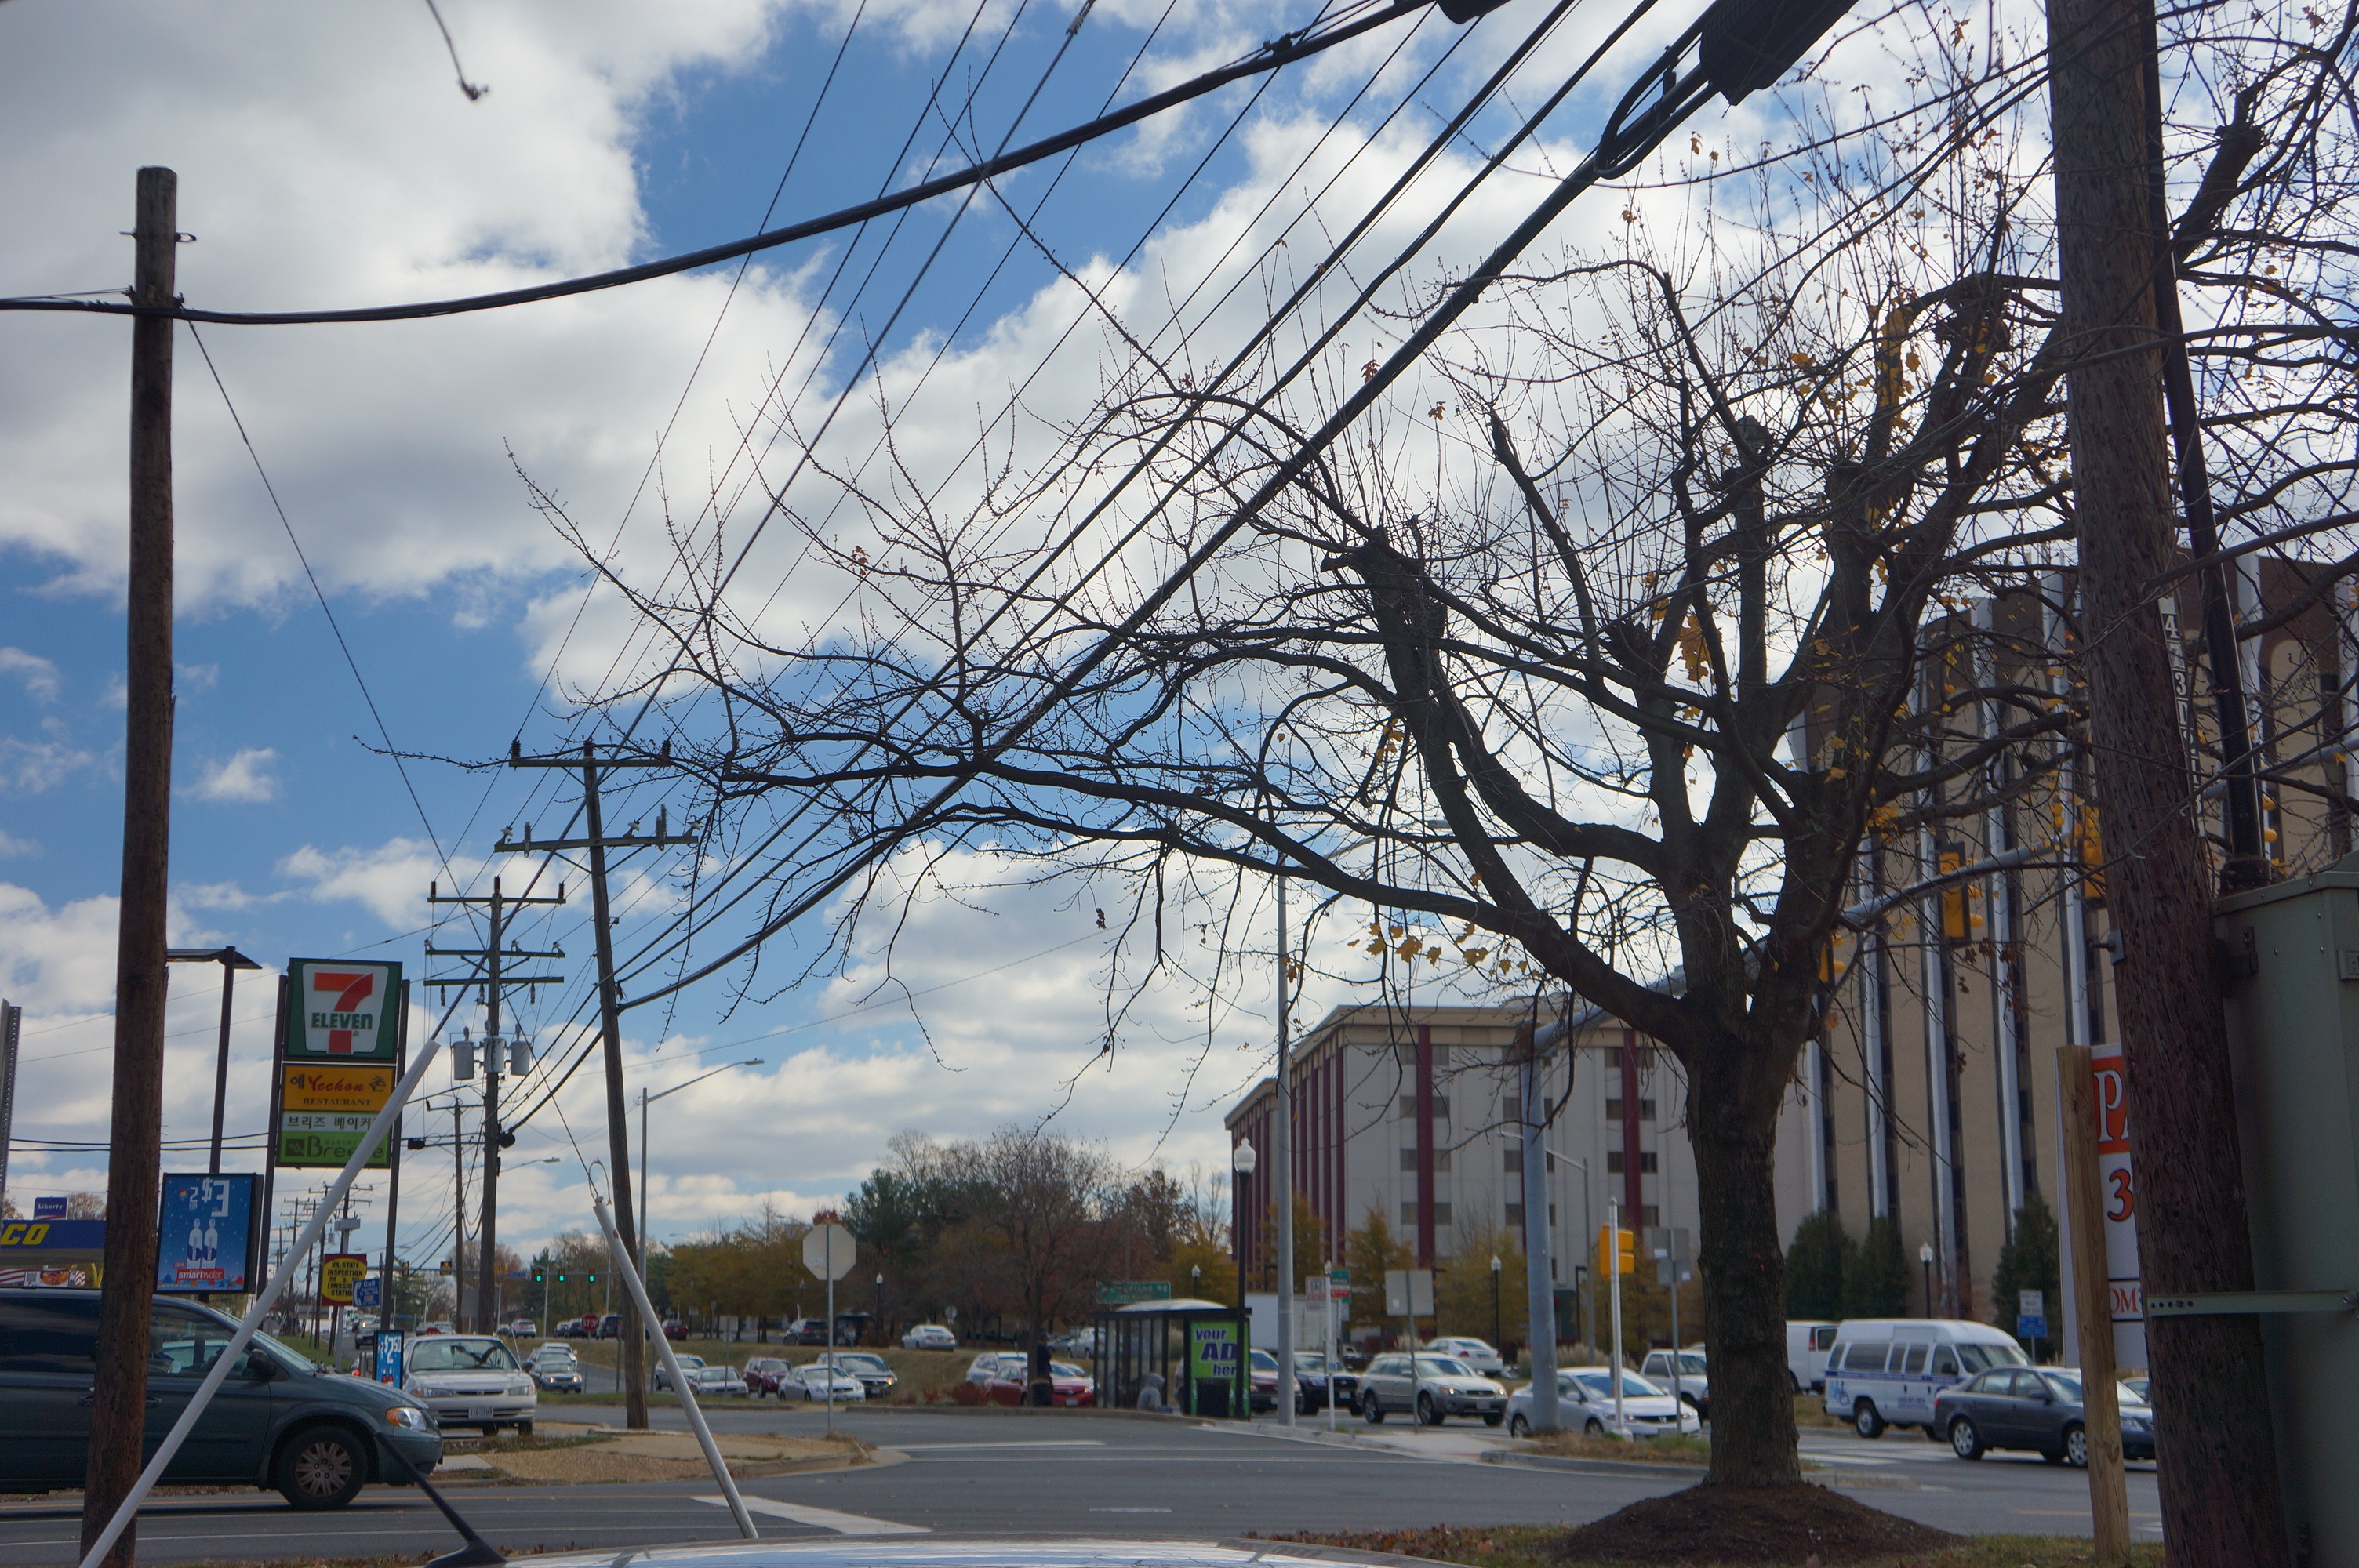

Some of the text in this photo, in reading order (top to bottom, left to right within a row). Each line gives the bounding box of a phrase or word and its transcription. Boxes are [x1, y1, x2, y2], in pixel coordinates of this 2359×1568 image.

[290, 1073, 305, 1090] 예
[307, 1075, 364, 1092] Yechon
[303, 1098, 371, 1106] RESTAURANT
[287, 1116, 375, 1130] 브리즈 베이커
[178, 1270, 222, 1280] smartwater
[582, 1319, 598, 1327] STOP
[1195, 1329, 1227, 1341] your
[1201, 1343, 1238, 1361] AD
[1212, 1364, 1237, 1377] her
